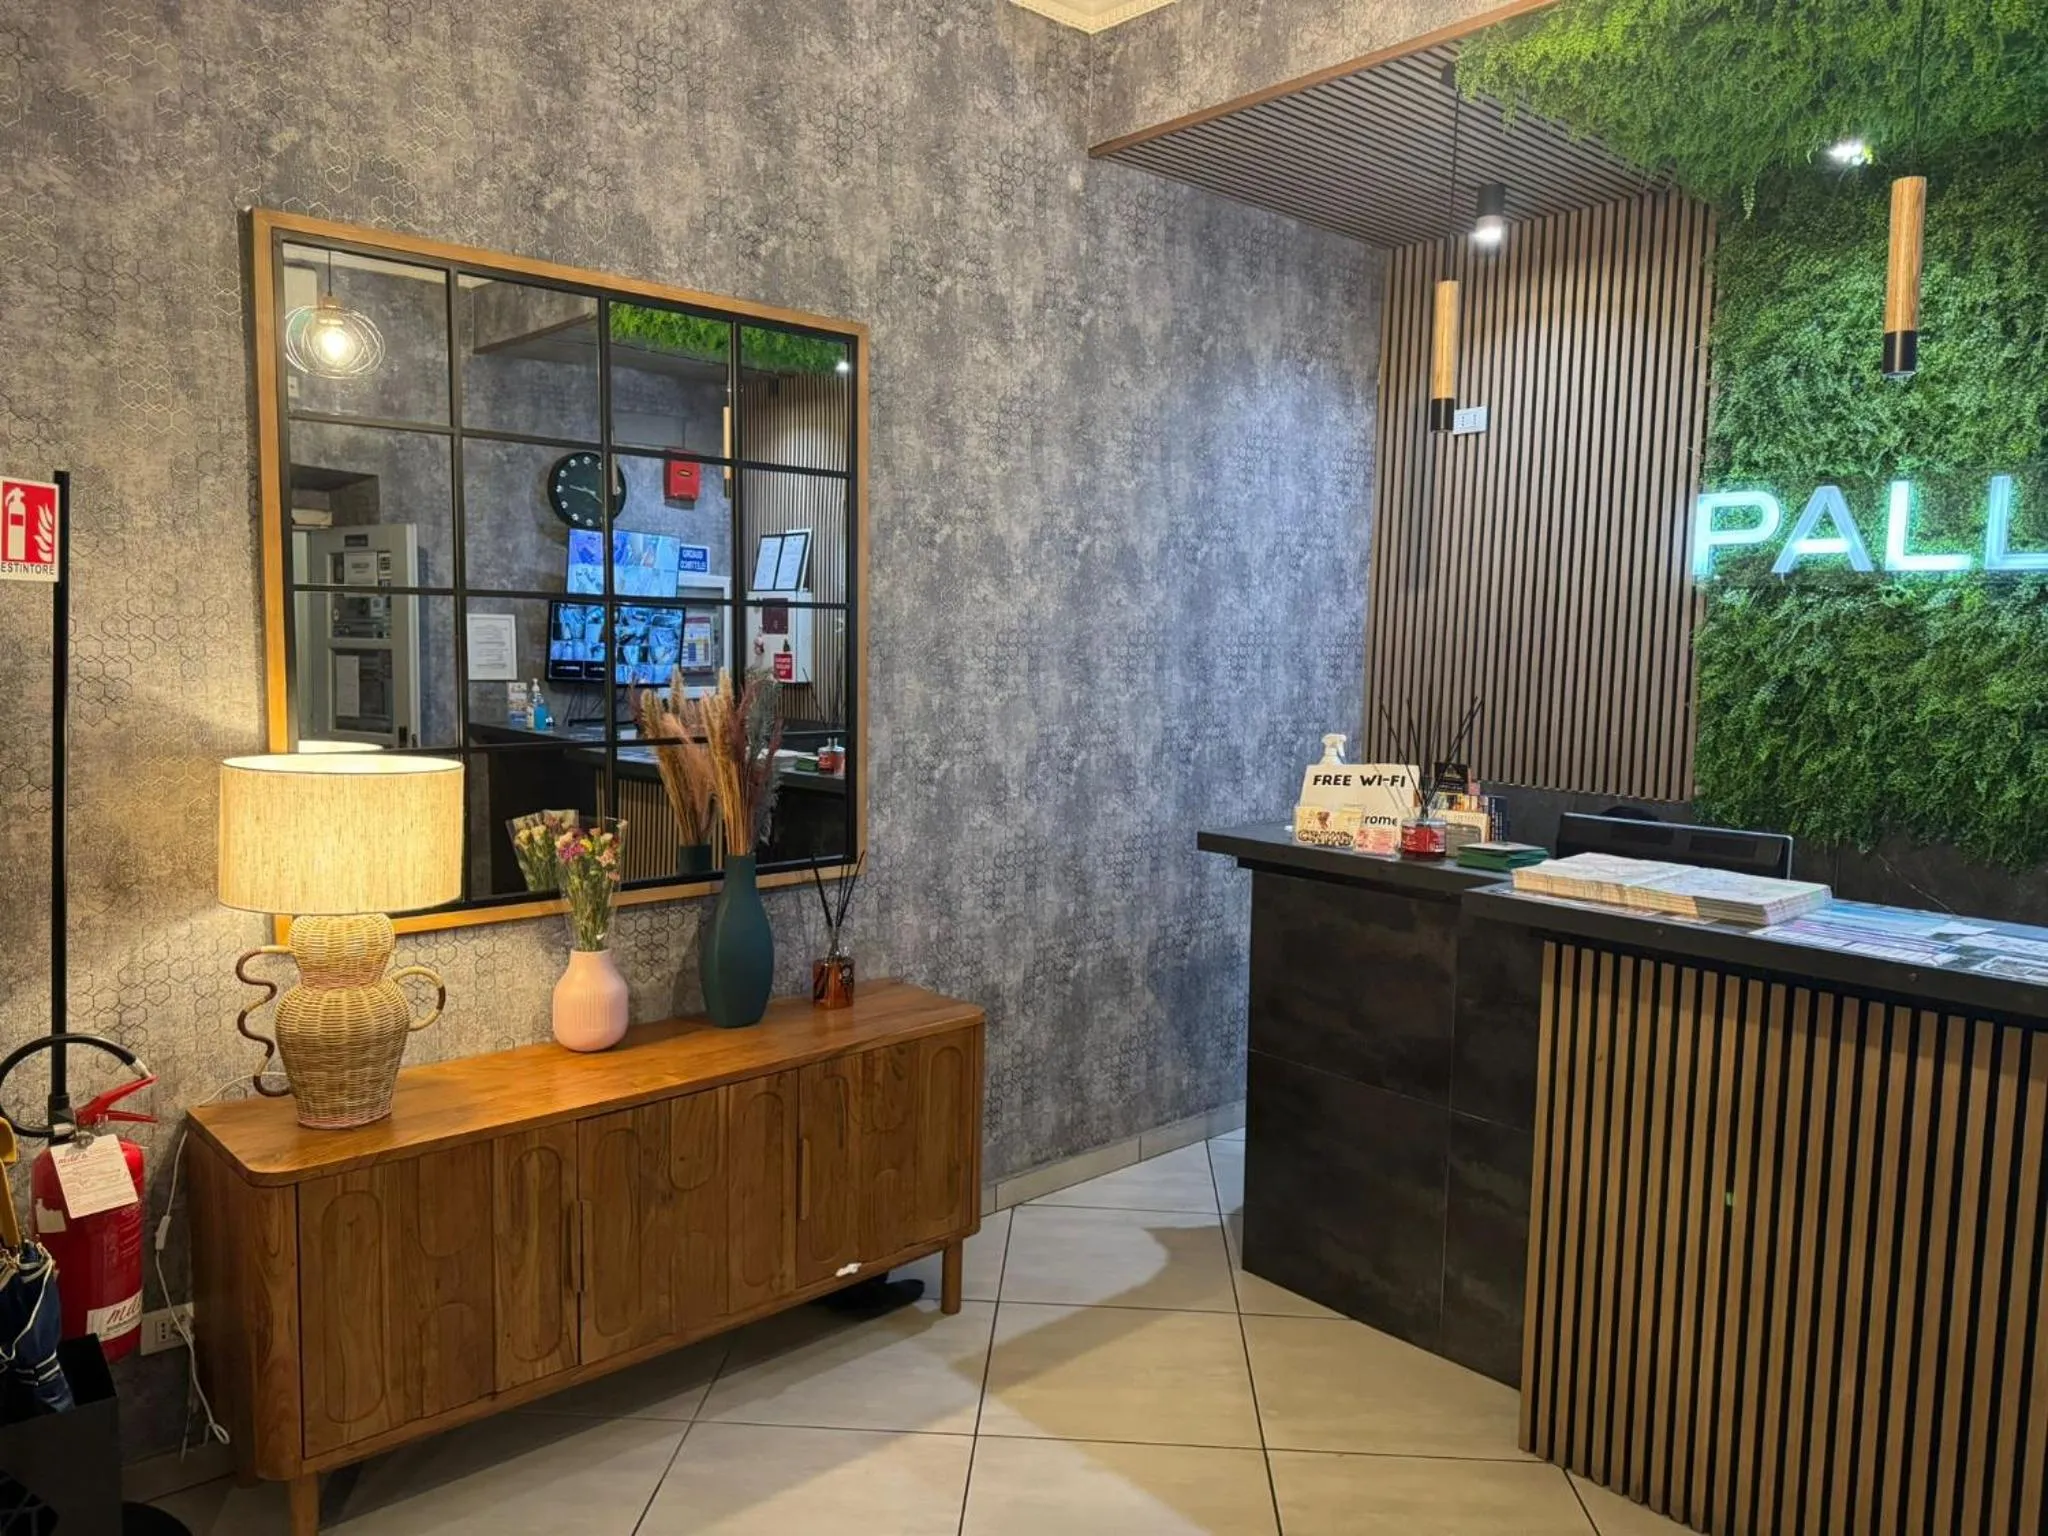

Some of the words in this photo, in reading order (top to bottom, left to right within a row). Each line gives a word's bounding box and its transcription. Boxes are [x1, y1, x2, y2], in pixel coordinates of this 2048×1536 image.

[1692, 475, 2048, 575] PALL
[1, 563, 55, 575] ESTINTORE
[1312, 774, 1353, 787] FREE
[1360, 774, 1406, 788] WI-FI
